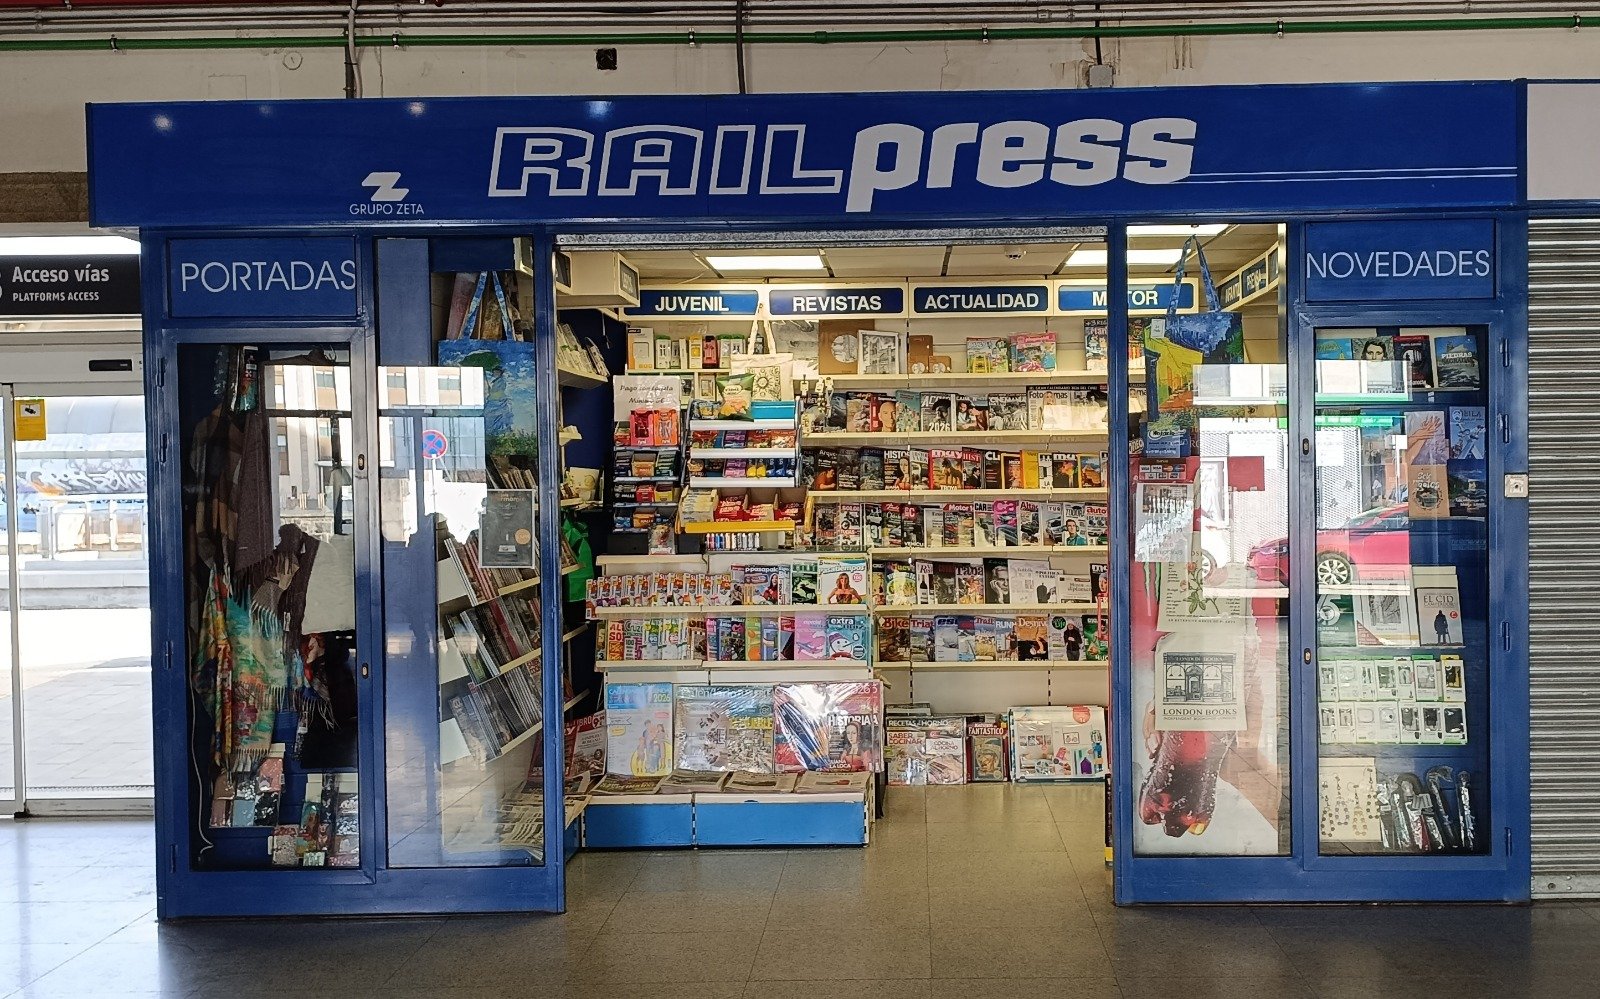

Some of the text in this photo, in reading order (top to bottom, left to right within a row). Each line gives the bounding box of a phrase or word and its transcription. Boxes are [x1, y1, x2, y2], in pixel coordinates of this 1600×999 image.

[349, 203, 425, 215] GRUPO ZETA
[1306, 250, 1490, 278] NOVEDADES
[12, 263, 110, 282] Acceso vías
[181, 260, 355, 293] PORTADAS
[12, 291, 100, 301] PLATFORMS ACCESS
[924, 292, 1039, 309] ACTUALIDAD
[655, 296, 730, 311] JUVENIL
[793, 295, 882, 311] REVISTAS
[928, 422, 951, 432] 2026
[974, 502, 987, 511] CAR
[1423, 594, 1454, 604] EL CID
[831, 617, 854, 625] extra
[883, 617, 909, 628] Bike
